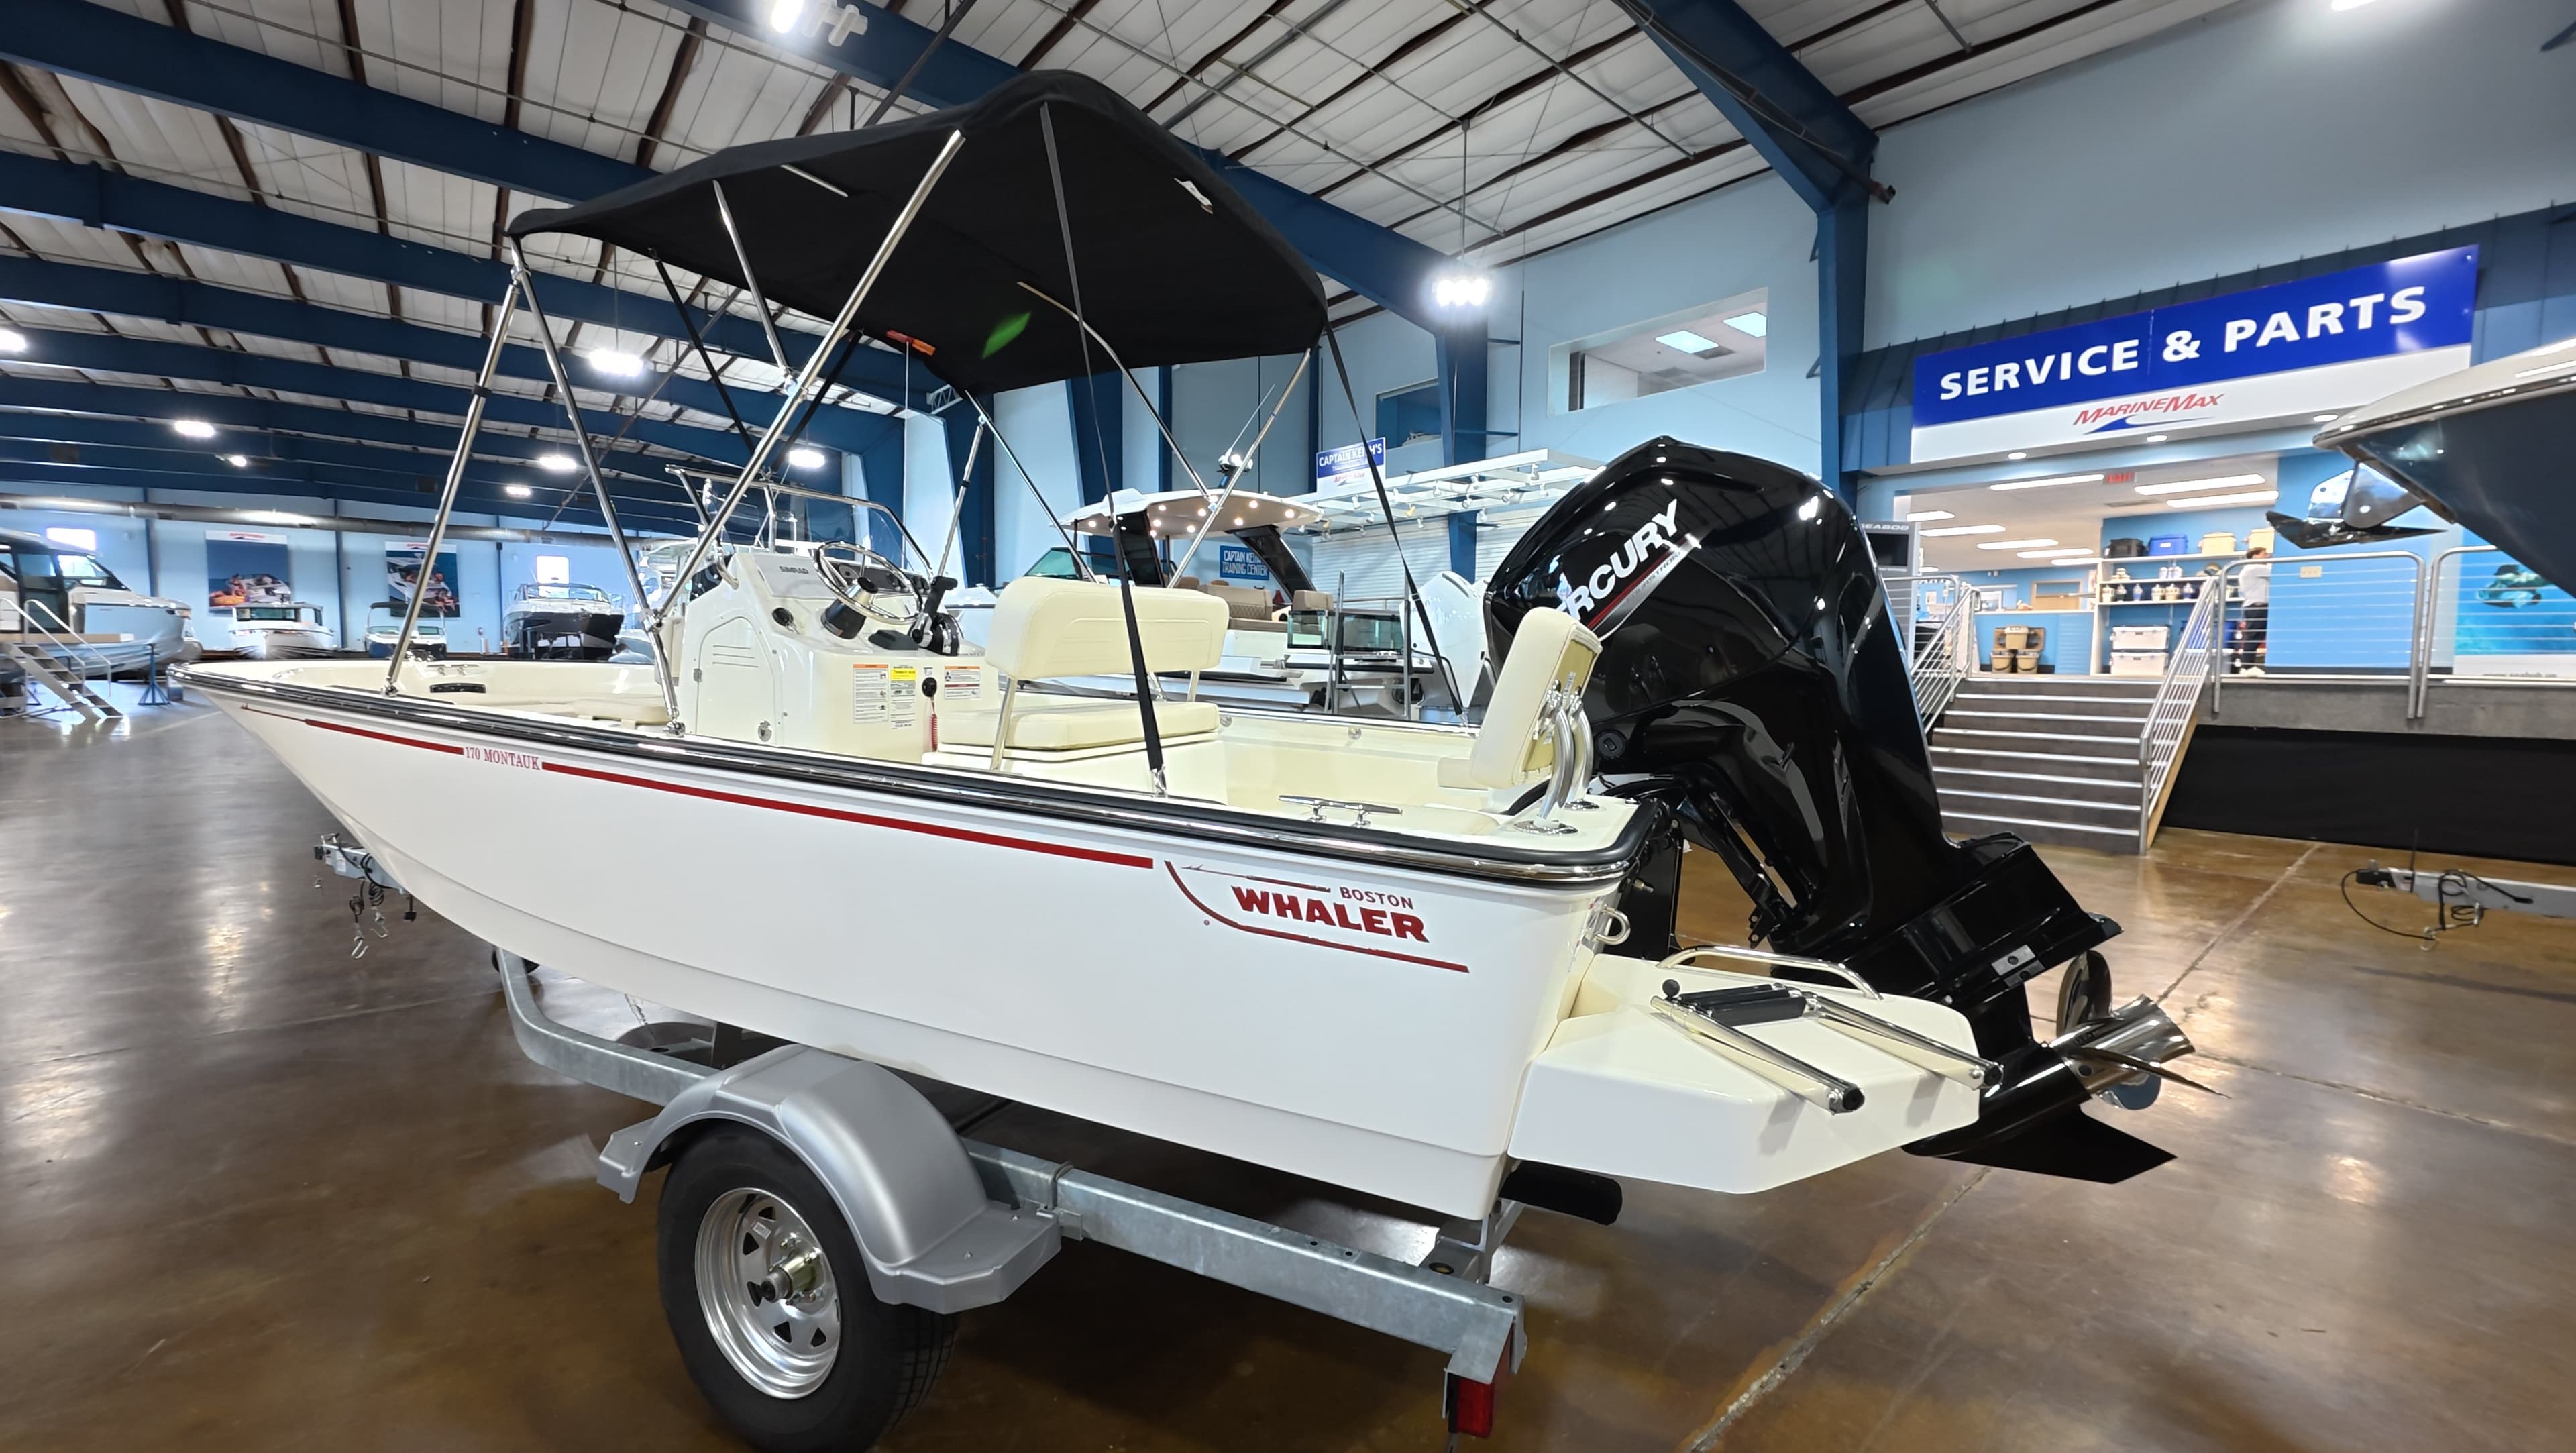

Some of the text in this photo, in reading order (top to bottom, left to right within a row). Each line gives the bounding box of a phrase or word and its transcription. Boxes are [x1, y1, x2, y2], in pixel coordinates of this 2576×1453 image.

[1939, 286, 2427, 400] SERVICE & PARTS
[1319, 449, 1351, 467] CAPTAIN
[1352, 443, 1383, 460] KEIH'S
[1222, 561, 1267, 576] TRAINING CENTER
[1224, 550, 1246, 563] CAPTAIN
[1556, 498, 1678, 621] RCURY
[466, 747, 541, 771] 170 MONTAUK
[1339, 886, 1415, 910] BOSTON
[1230, 885, 1430, 943] WHALER
